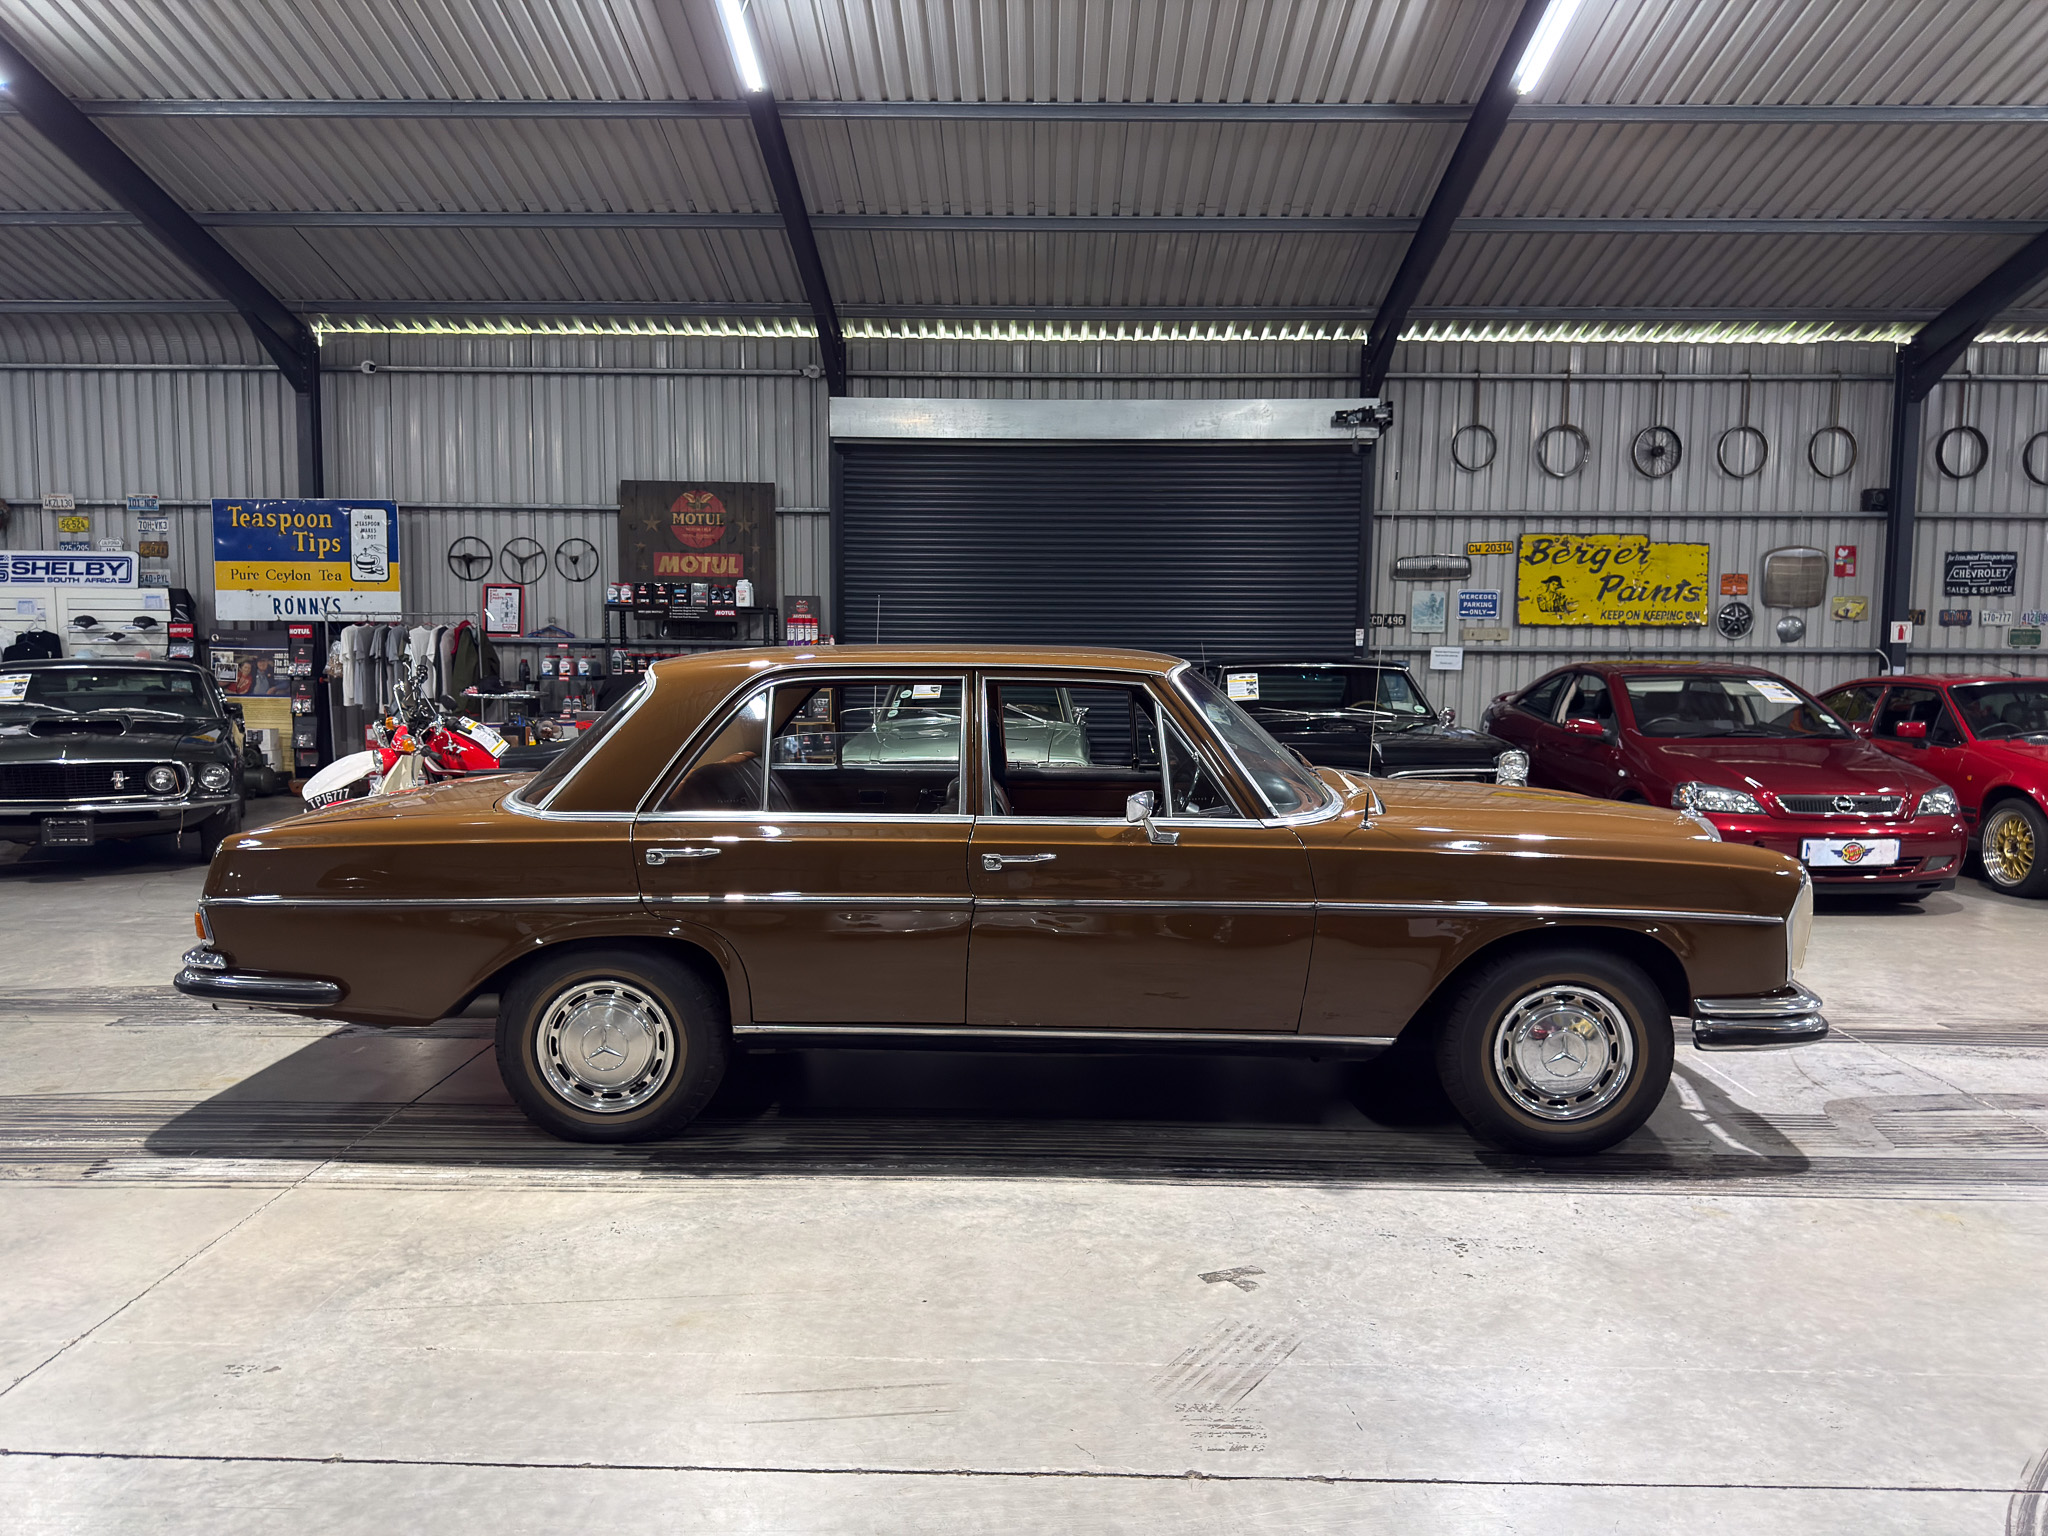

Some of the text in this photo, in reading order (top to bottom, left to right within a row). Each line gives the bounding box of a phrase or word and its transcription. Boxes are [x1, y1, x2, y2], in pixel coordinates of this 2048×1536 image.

[227, 505, 333, 535] Teaspoon
[671, 512, 725, 525] MOTUL
[292, 530, 341, 559] Tips
[1468, 543, 1512, 553] CW 20314
[1524, 538, 1651, 574] Berger
[11, 561, 126, 576] SHELBY
[658, 555, 739, 574] MOTUL
[84, 576, 118, 584] AFRICA
[230, 568, 342, 583] Pure Ceylon Tea
[1953, 568, 2008, 578] CHEVROLET
[1596, 574, 1703, 602] Paints
[1946, 585, 2013, 594] SALES & SERVICE
[1600, 609, 1625, 620] KEEP
[1625, 610, 1640, 620] ON
[307, 788, 350, 809] TP16777
